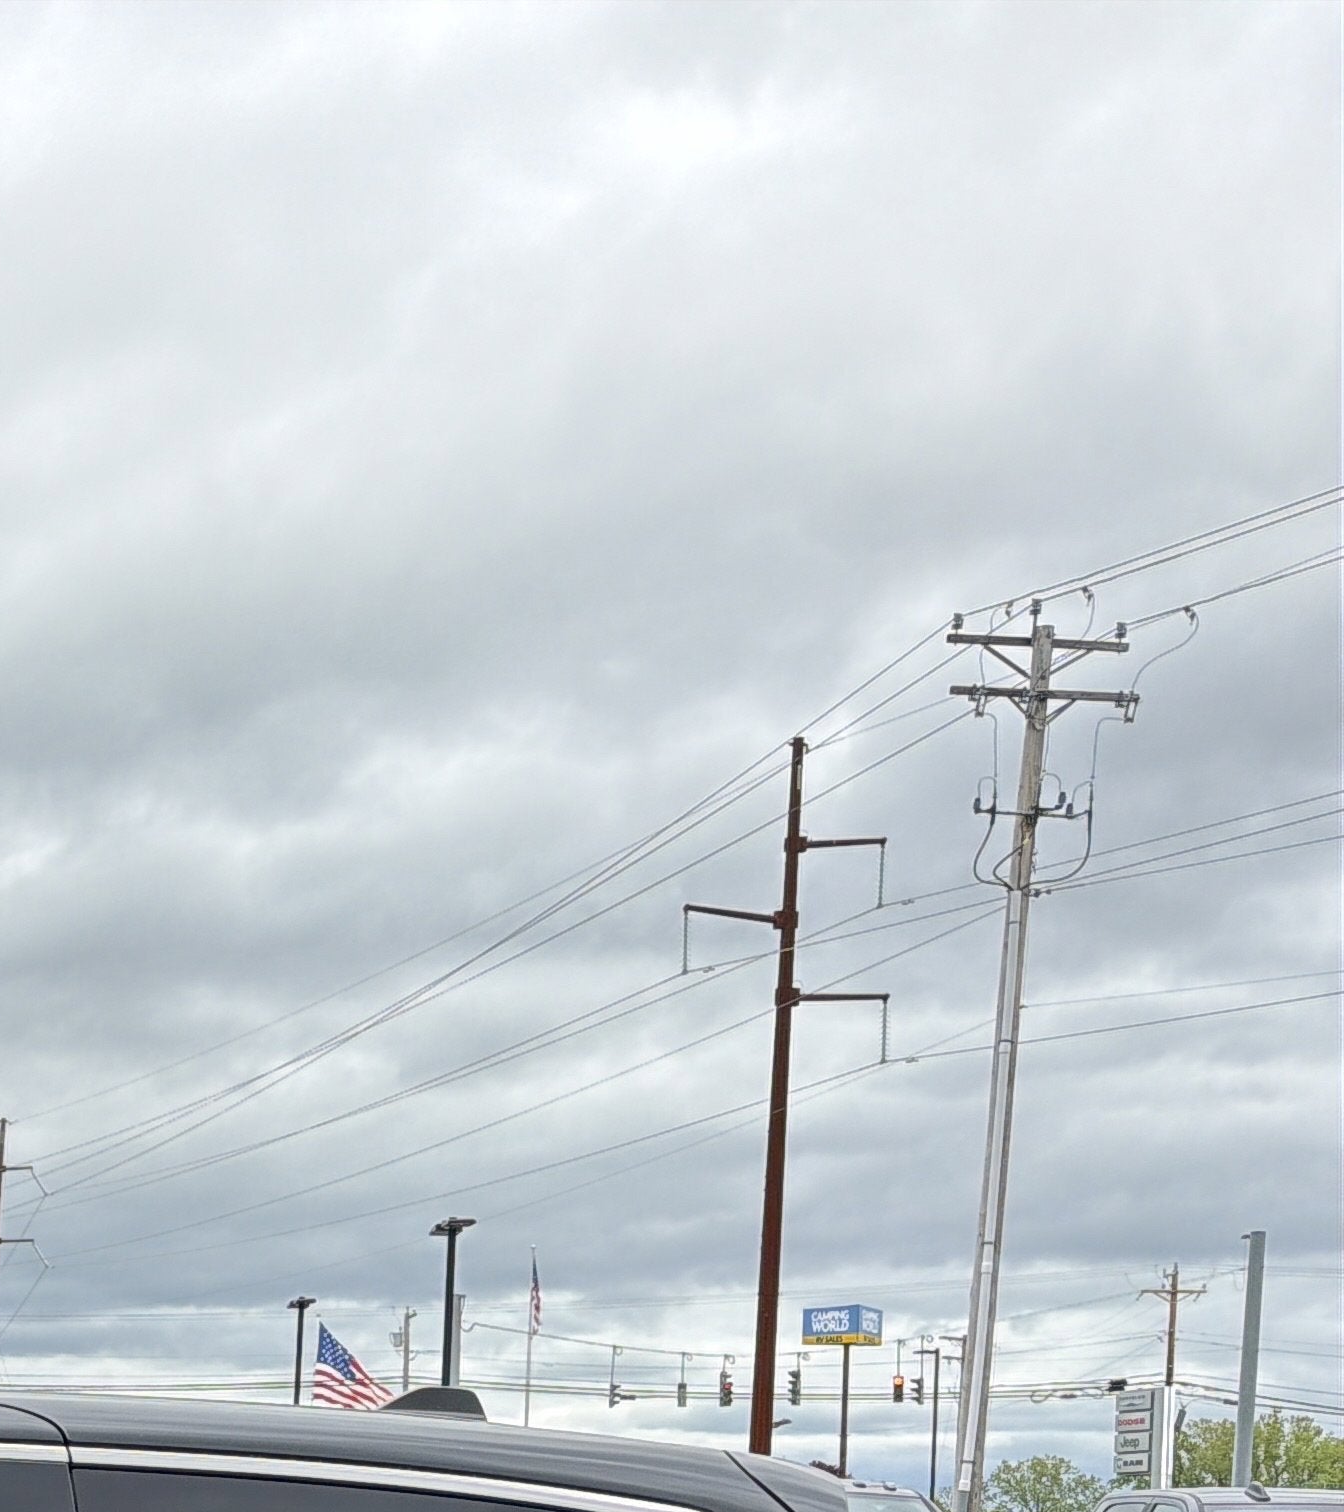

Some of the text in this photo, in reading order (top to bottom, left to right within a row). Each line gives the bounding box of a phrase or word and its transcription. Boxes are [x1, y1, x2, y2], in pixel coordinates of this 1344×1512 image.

[811, 1309, 850, 1321] CAMPING
[811, 1320, 850, 1333] WORLD
[825, 1335, 843, 1343] SALES
[1119, 1436, 1140, 1450] Jeep
[1122, 1459, 1144, 1467] RAM
